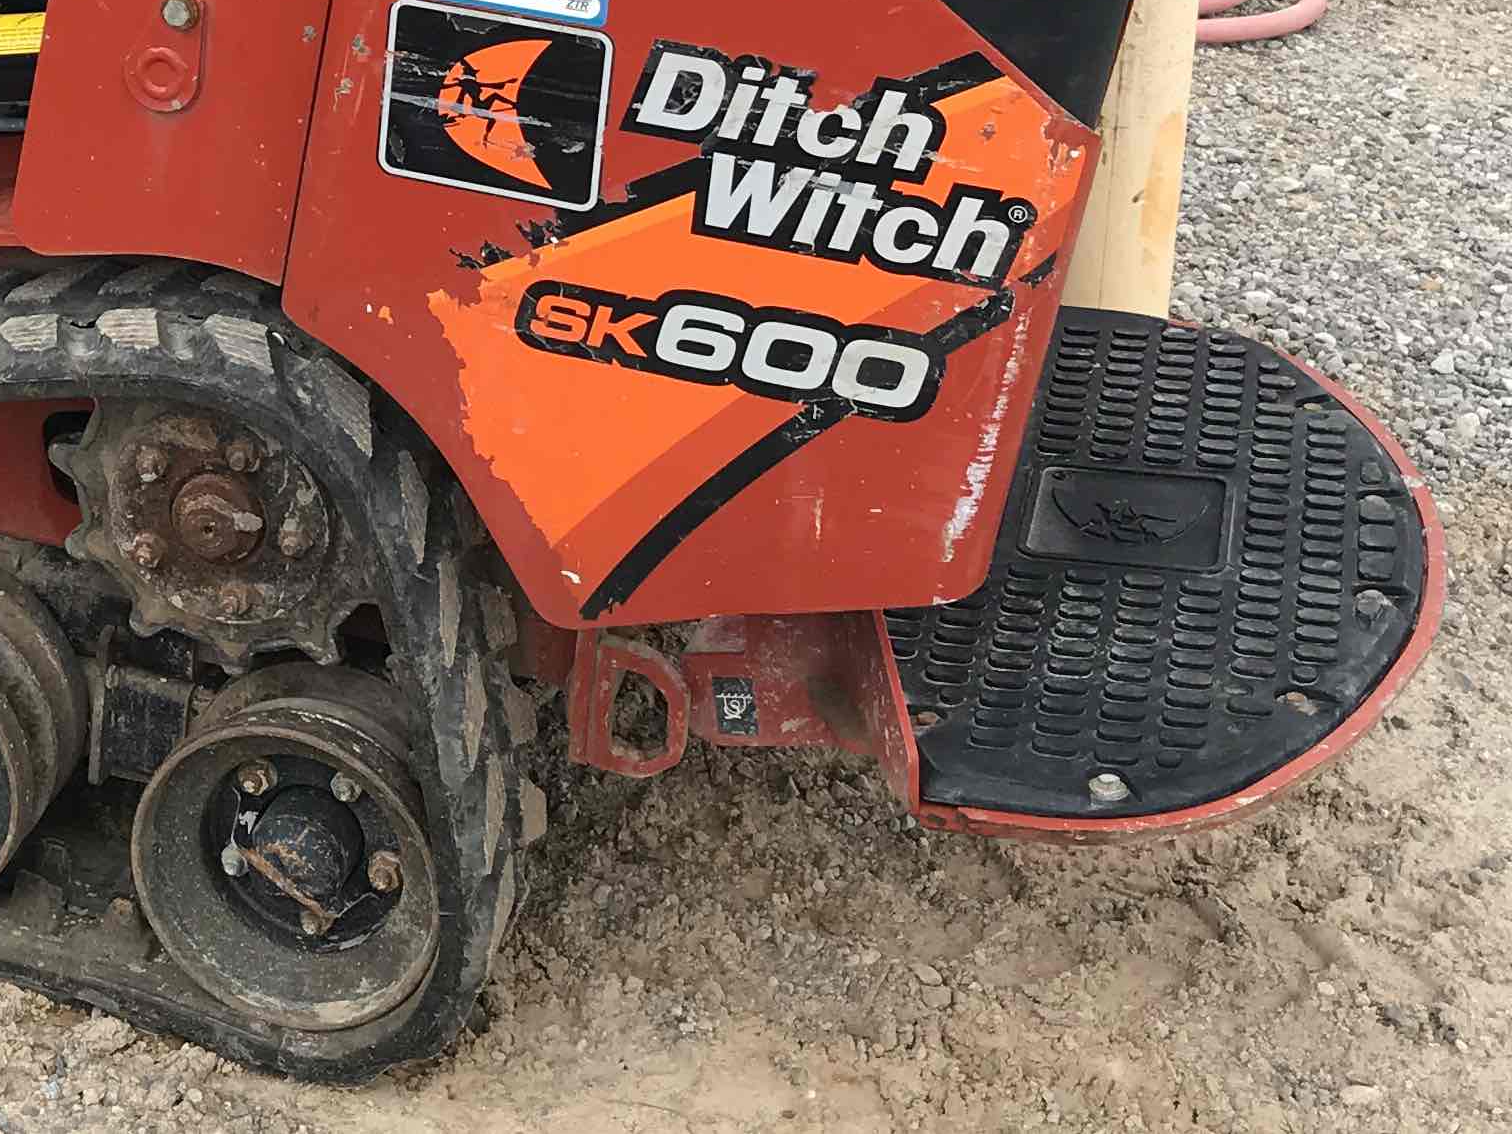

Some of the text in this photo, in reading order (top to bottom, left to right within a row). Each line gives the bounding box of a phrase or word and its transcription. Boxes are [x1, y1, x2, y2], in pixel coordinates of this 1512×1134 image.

[636, 50, 933, 172] Ditch
[704, 152, 1011, 279] Witch
[530, 293, 930, 408] SK600
